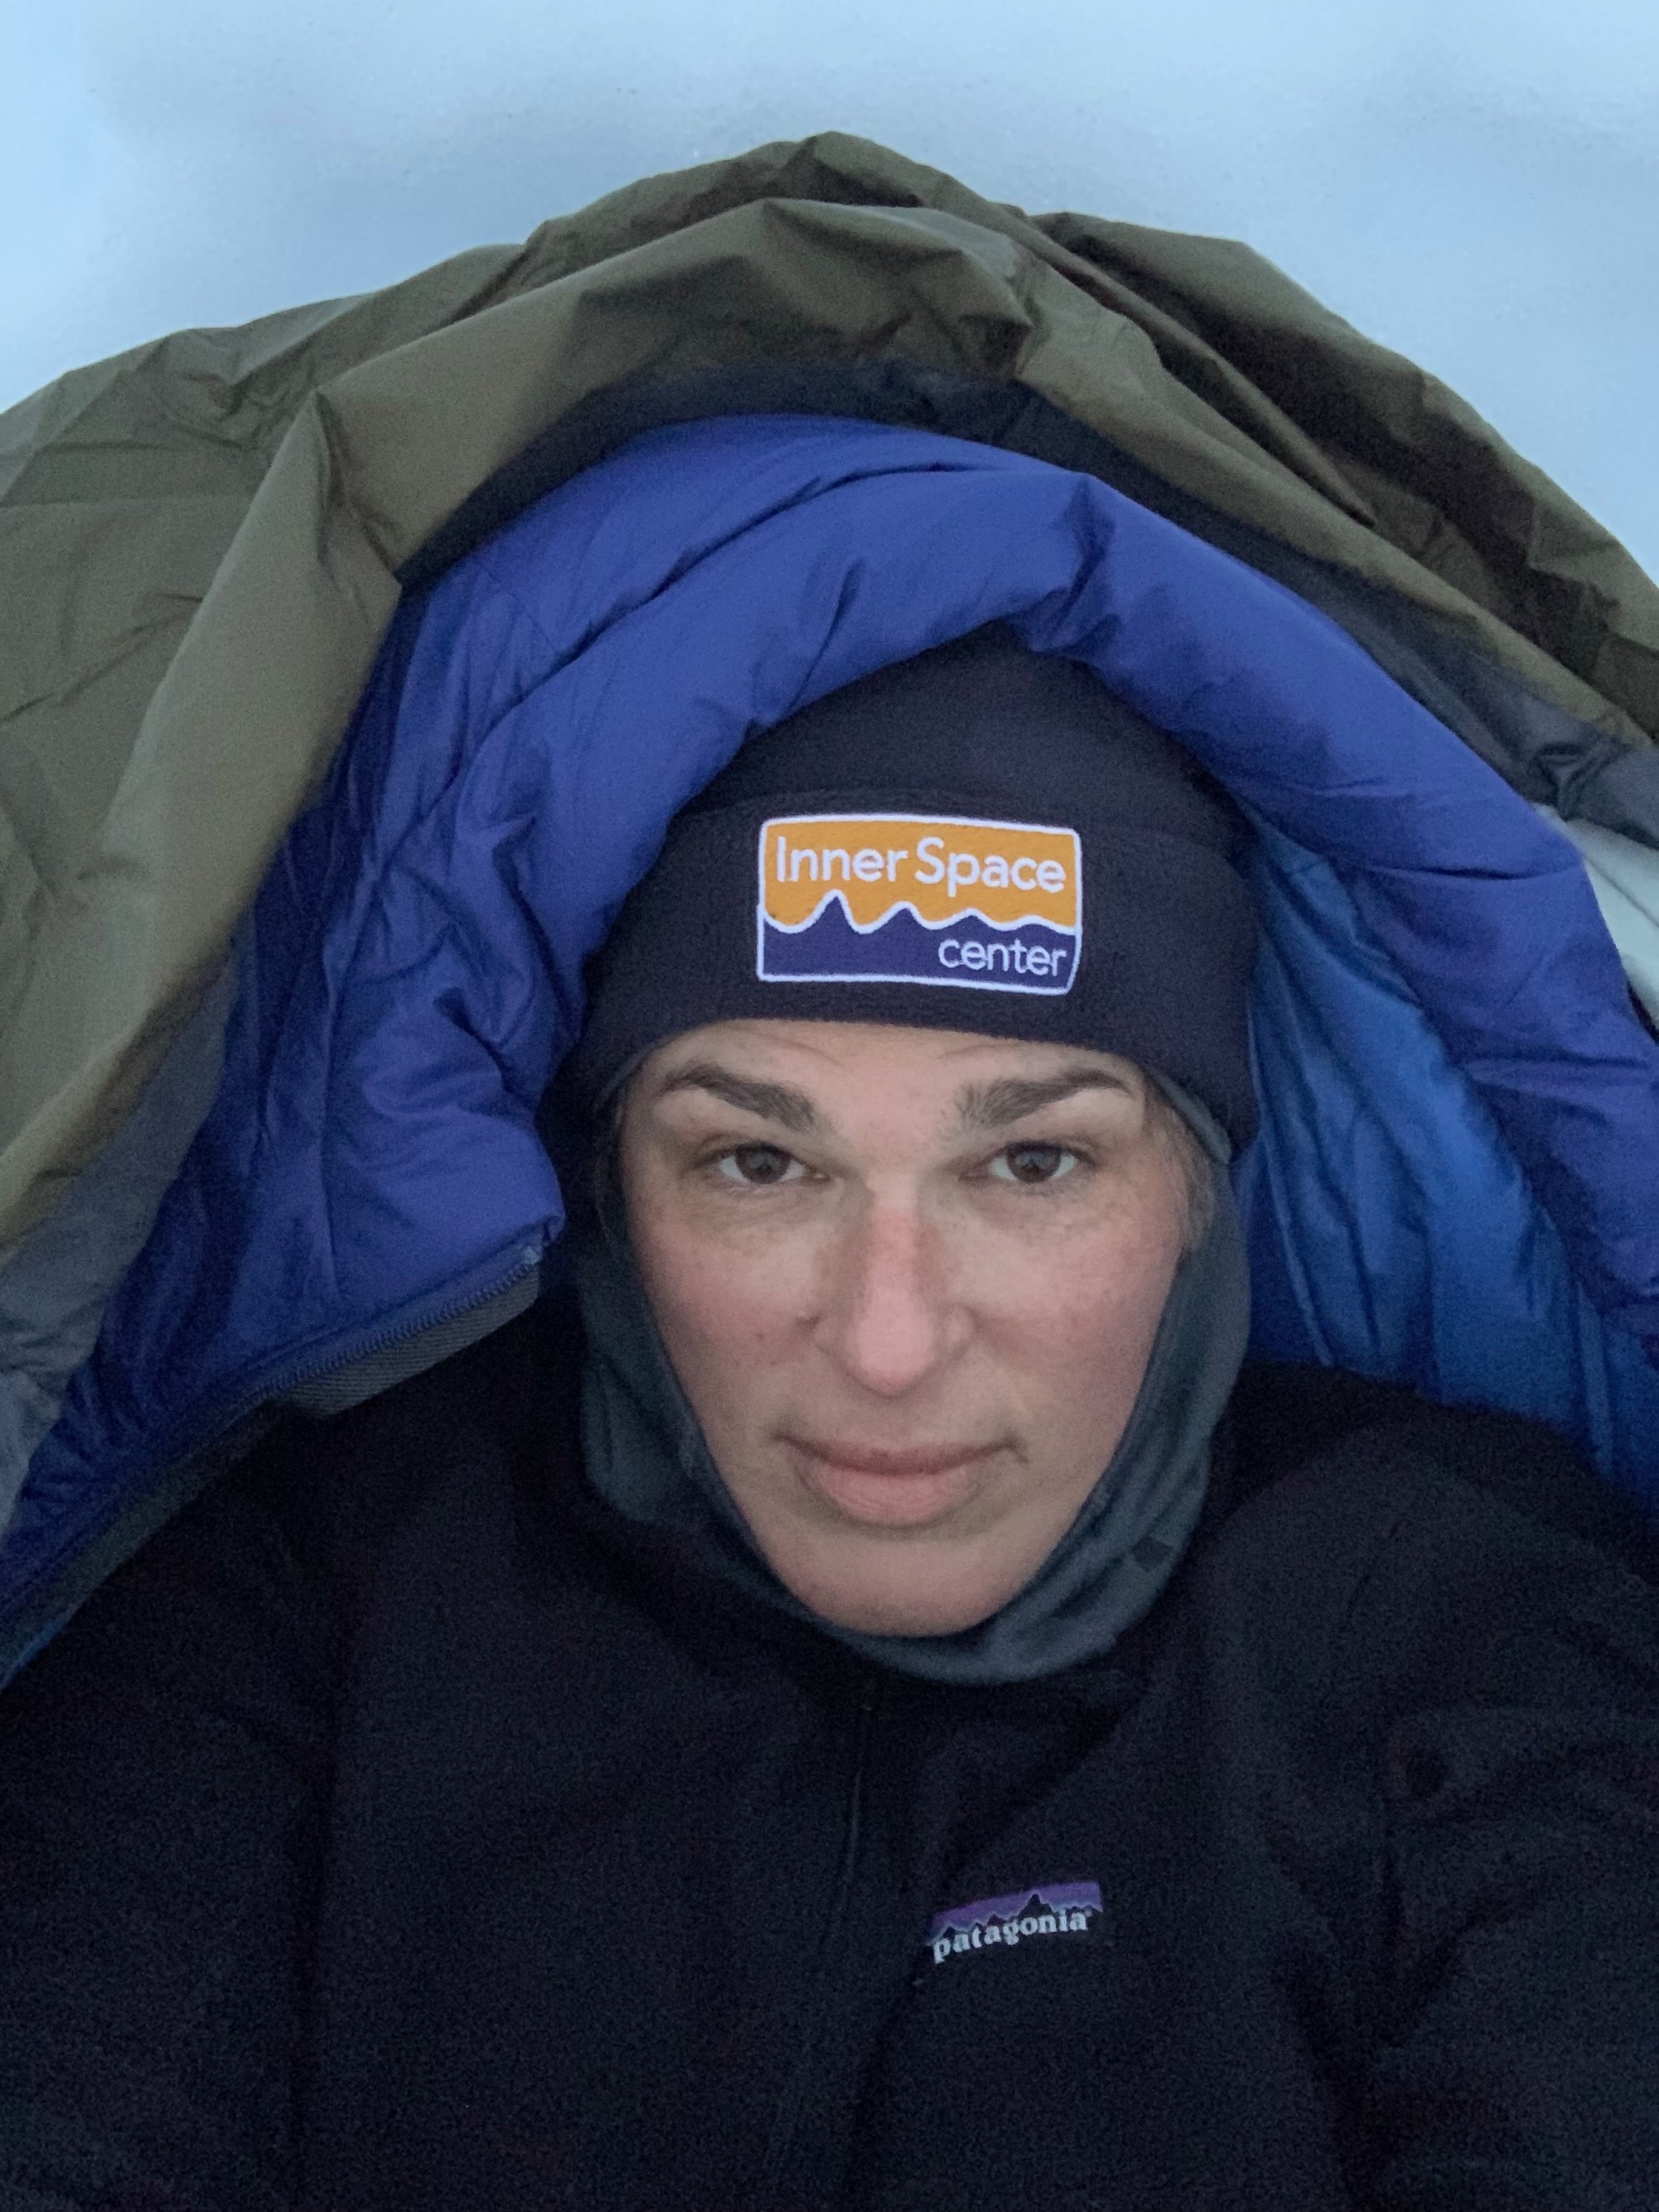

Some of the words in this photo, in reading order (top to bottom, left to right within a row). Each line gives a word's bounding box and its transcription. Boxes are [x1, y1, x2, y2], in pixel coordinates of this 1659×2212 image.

[776, 836, 908, 883] Inner
[915, 837, 1067, 898] Space
[938, 938, 1067, 977] center
[933, 1909, 1088, 1964] patagonia
